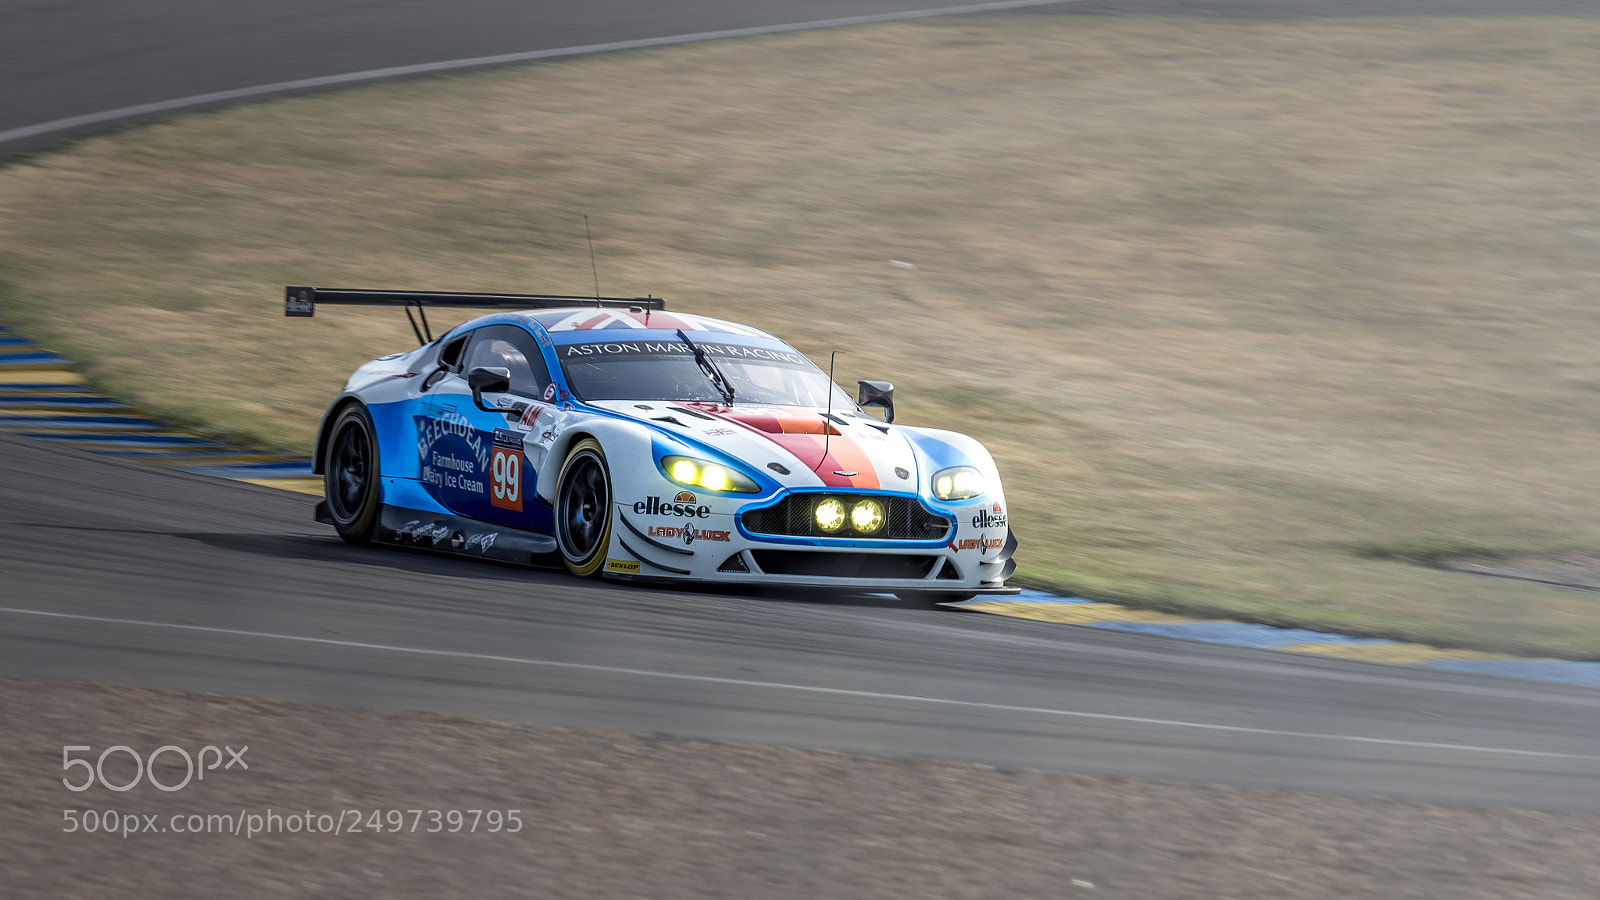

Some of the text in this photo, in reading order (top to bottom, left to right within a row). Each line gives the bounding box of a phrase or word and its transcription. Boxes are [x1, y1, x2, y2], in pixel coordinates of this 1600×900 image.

[567, 342, 640, 357] ASTON
[727, 345, 804, 364] RACING
[432, 450, 474, 473] Farmhouse
[444, 471, 457, 488] Ice
[458, 473, 484, 494] Cream
[493, 452, 519, 502] 99
[633, 496, 710, 518] ellesse
[648, 526, 731, 542] LADY LUCK
[959, 539, 1003, 549] LADY LUCK
[610, 562, 640, 570] DUNLOP
